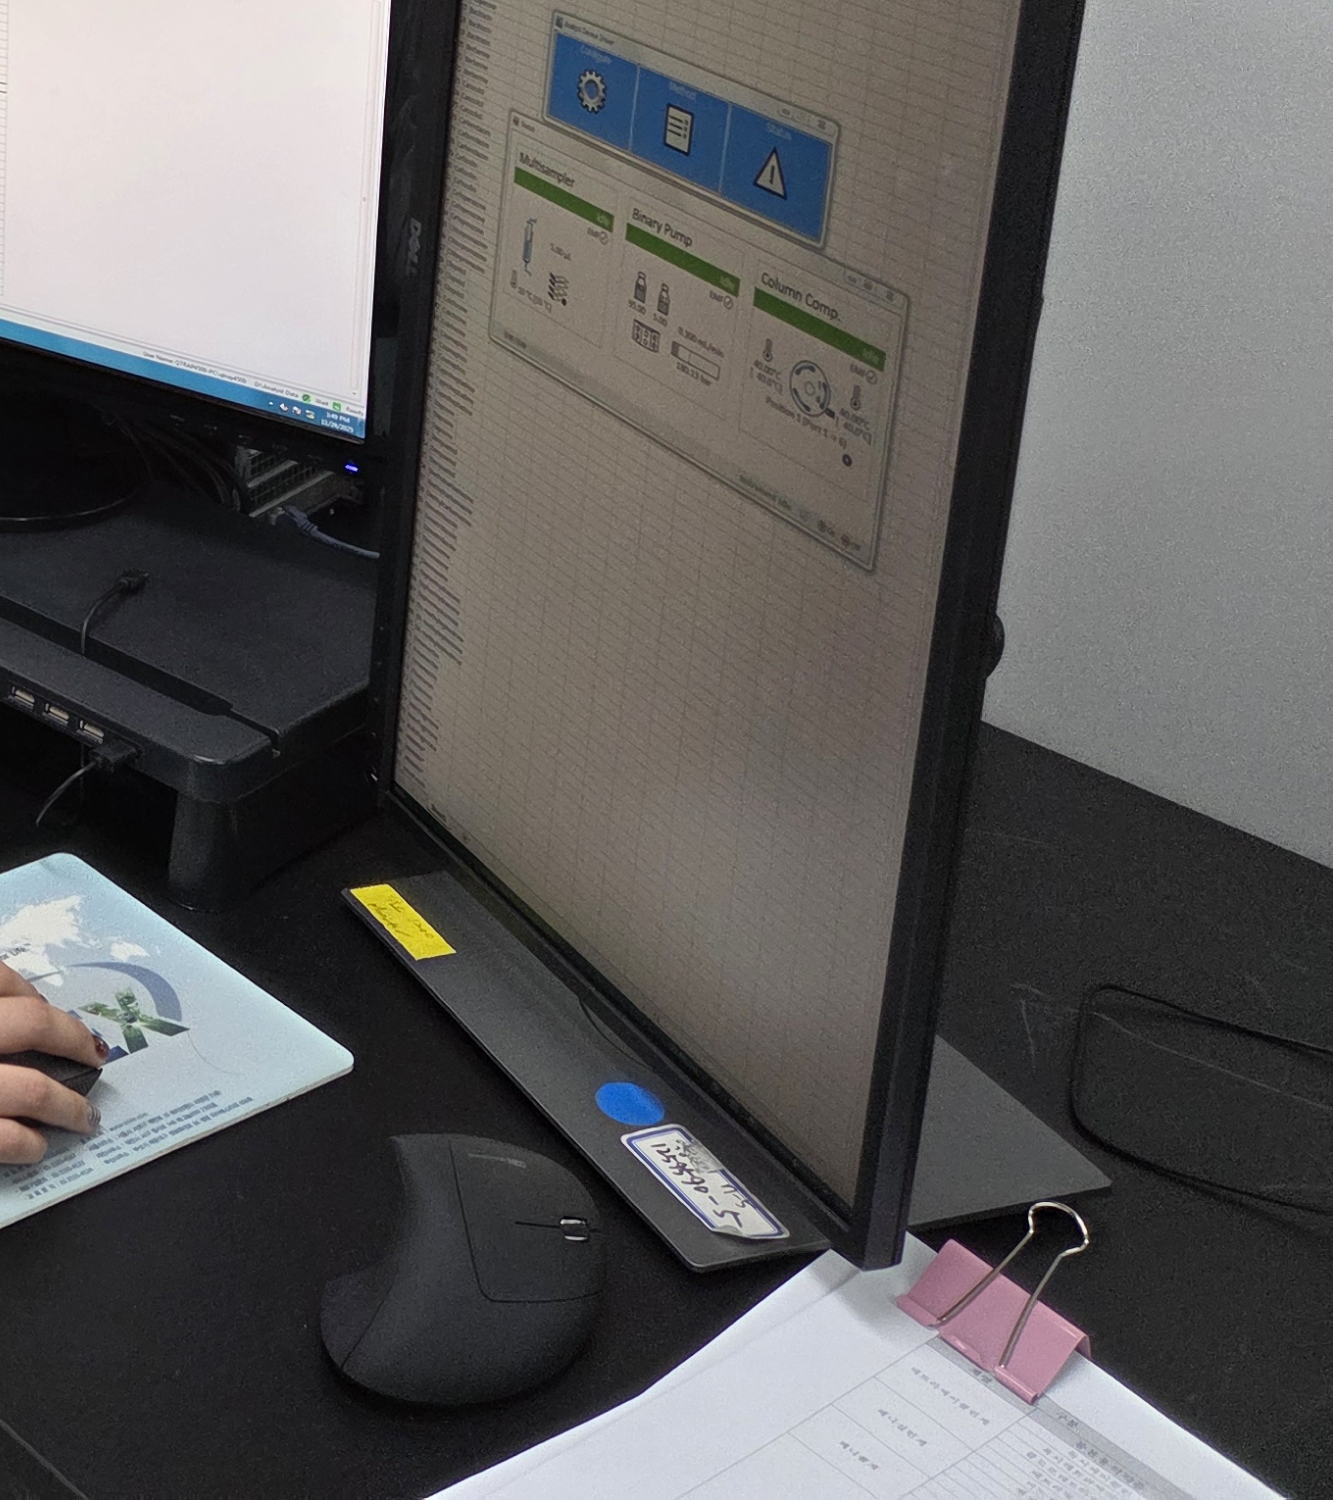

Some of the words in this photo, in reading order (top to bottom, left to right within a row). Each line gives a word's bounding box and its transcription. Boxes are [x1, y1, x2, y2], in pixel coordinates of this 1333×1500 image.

[765, 121, 792, 141] Status
[519, 152, 575, 188] Multisampler
[632, 207, 663, 234] Binary
[663, 222, 693, 248] Pump
[760, 271, 803, 302] Column
[804, 292, 842, 323] Comp.
[339, 415, 351, 424] PM
